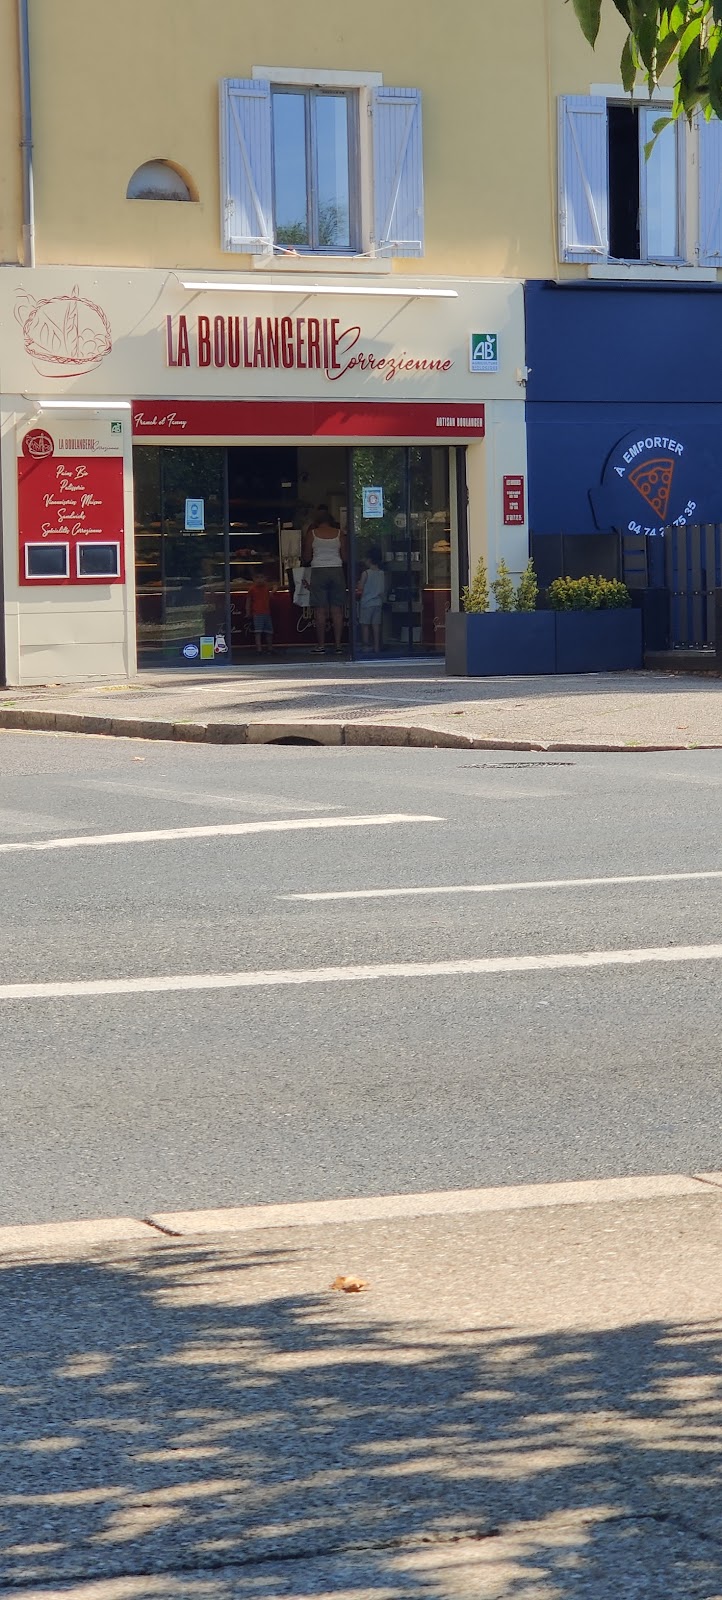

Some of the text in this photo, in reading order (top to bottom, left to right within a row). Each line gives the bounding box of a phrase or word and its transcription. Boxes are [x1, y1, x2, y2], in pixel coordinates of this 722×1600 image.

[166, 314, 453, 381] LA BOULANGERIE Correzienne
[473, 341, 494, 360] AB
[134, 412, 187, 429] Franck et Fanny
[436, 417, 483, 428] ARTISAN BOULANGER
[58, 439, 64, 449] LA
[65, 439, 95, 449] BOULANGERIE
[623, 437, 684, 464] EMPORTER
[56, 465, 89, 479] Pains Bio
[81, 494, 102, 508] Maison
[628, 521, 642, 535] 04
[685, 500, 697, 516] 35
